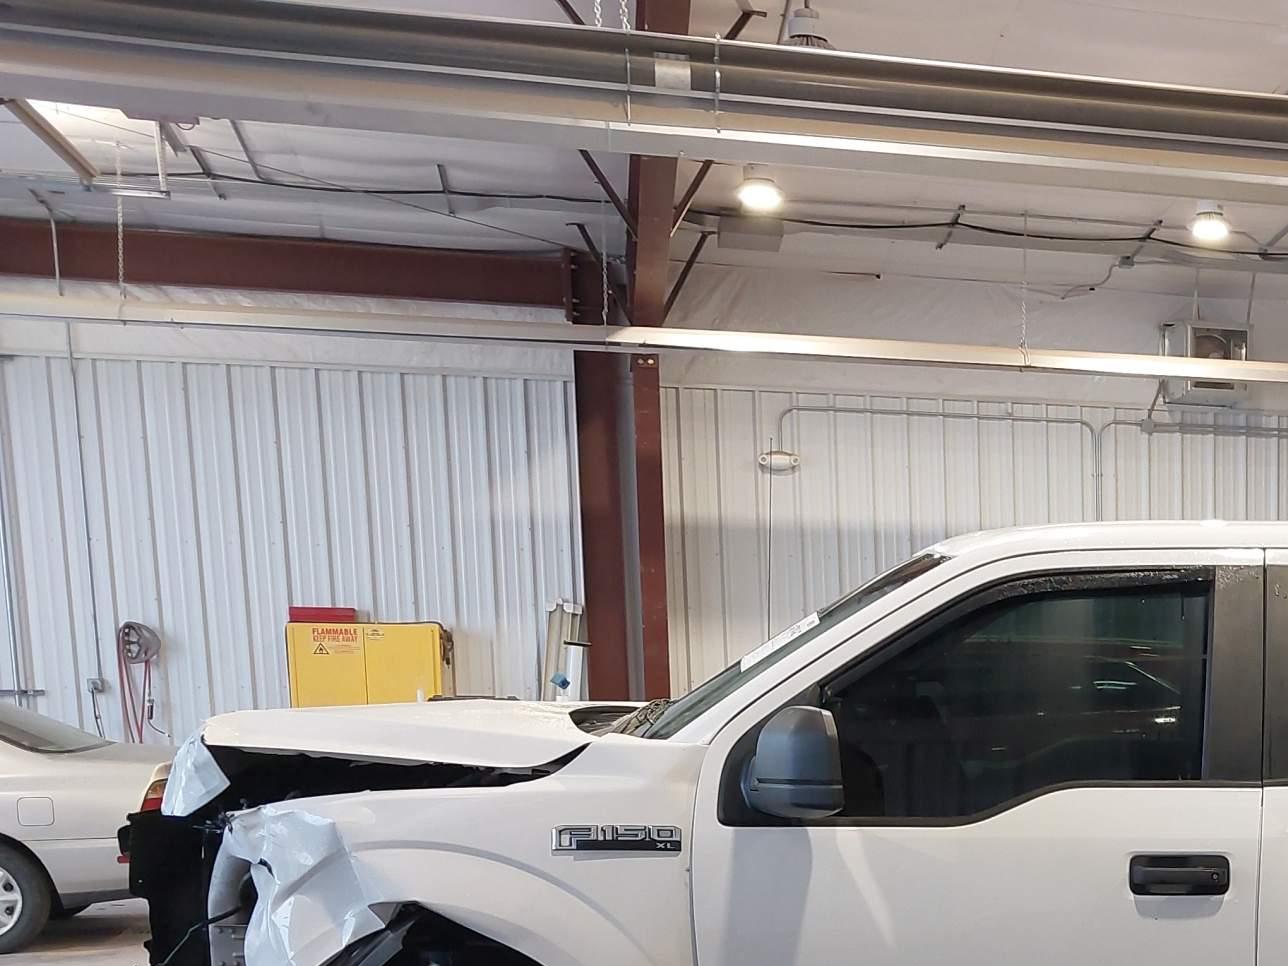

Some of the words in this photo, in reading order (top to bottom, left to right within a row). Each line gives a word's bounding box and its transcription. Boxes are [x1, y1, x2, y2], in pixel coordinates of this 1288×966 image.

[312, 627, 358, 636] FLAMMABLE
[341, 635, 358, 643] AWAY
[551, 824, 682, 850] F150
